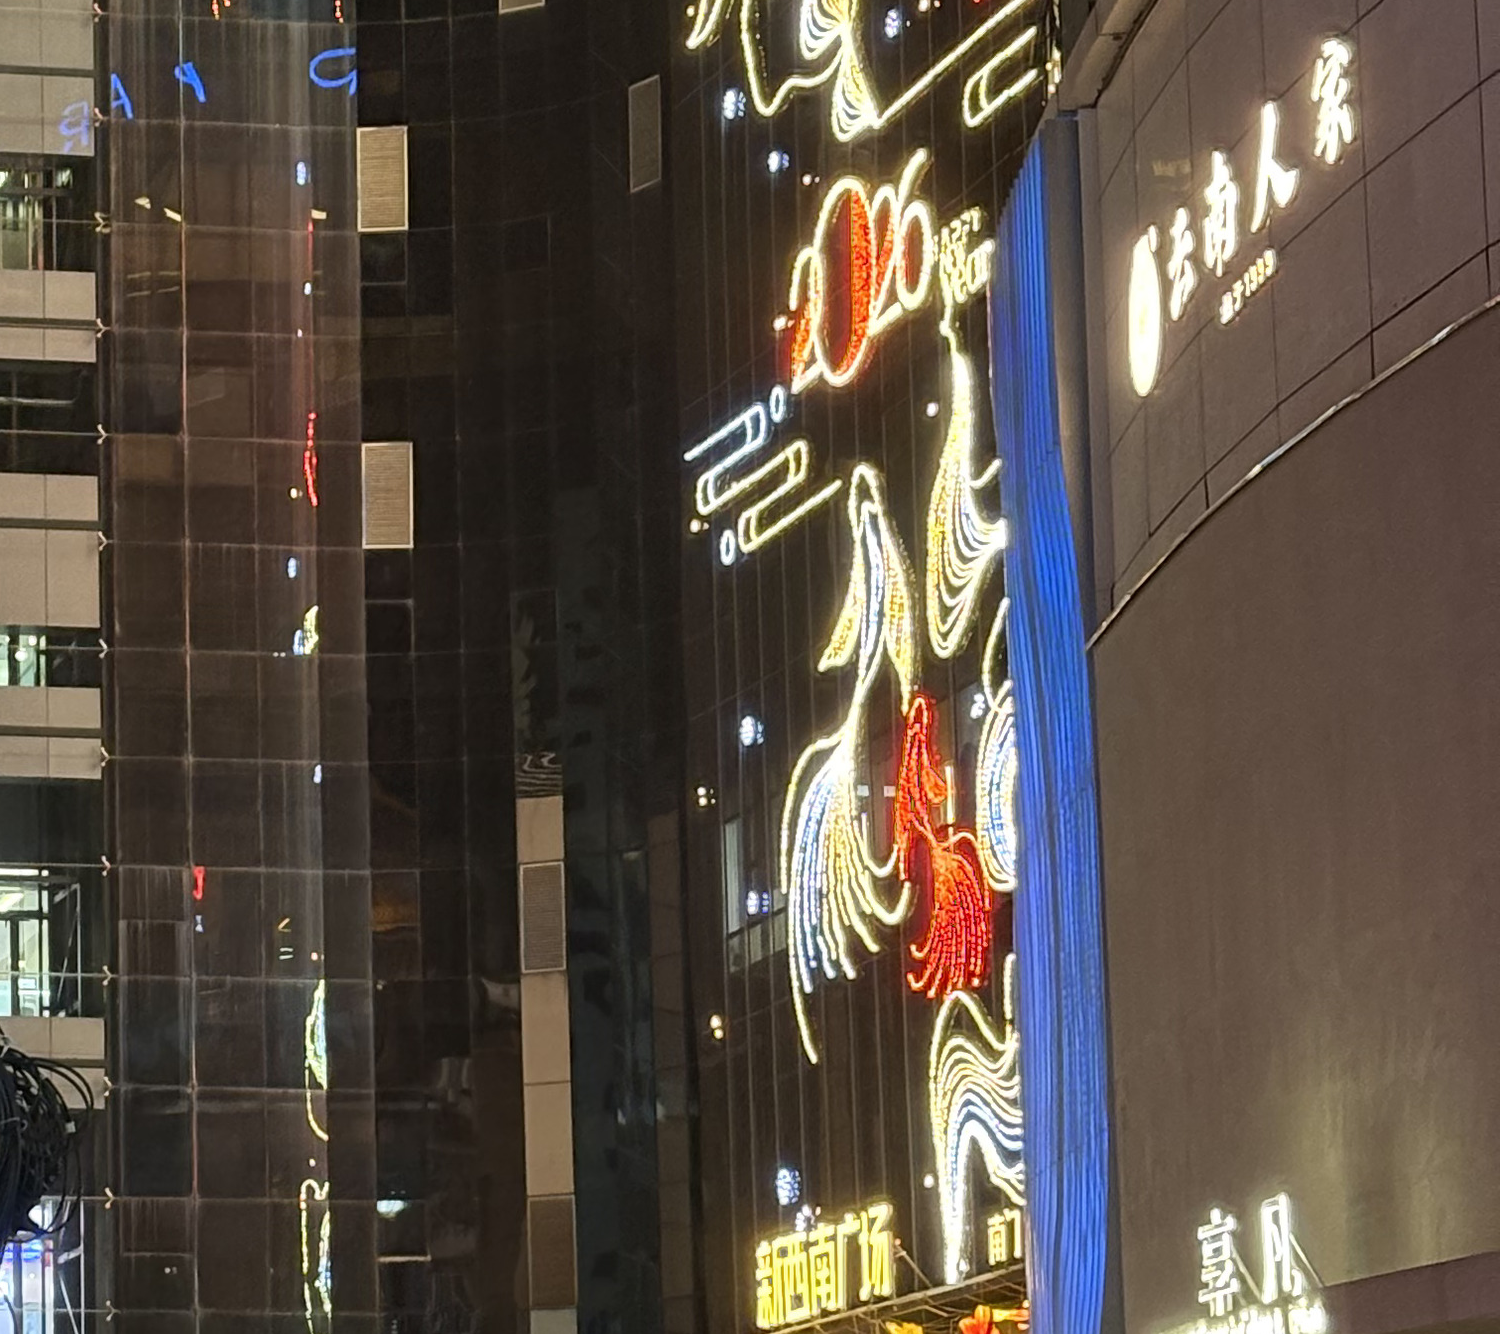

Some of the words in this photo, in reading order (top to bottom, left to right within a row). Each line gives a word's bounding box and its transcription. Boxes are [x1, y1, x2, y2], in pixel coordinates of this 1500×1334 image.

[1168, 38, 1358, 322] 云南人家
[755, 1202, 894, 1330] 新西南广场
